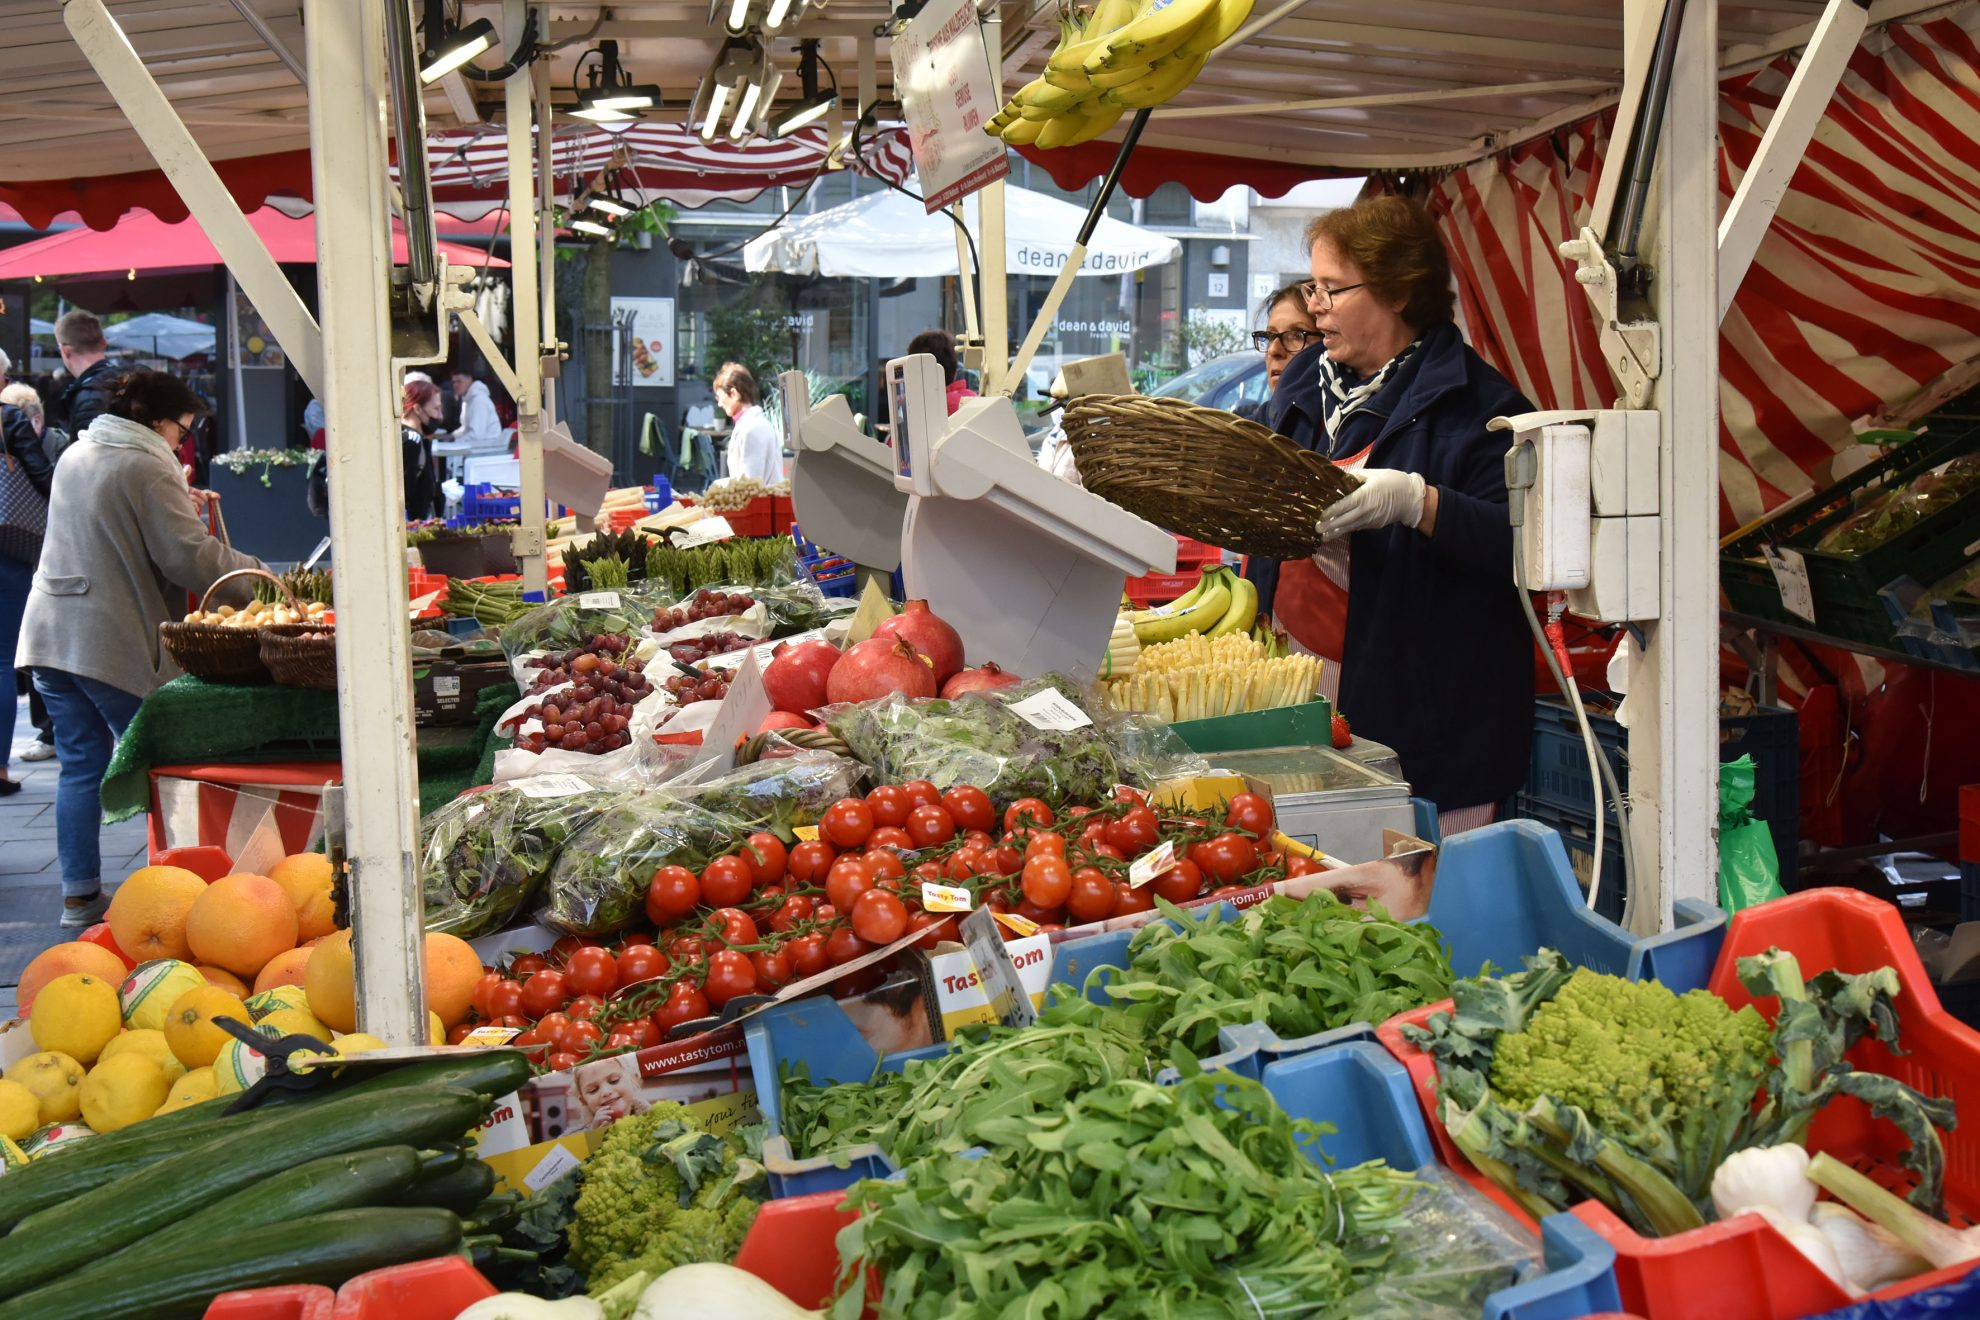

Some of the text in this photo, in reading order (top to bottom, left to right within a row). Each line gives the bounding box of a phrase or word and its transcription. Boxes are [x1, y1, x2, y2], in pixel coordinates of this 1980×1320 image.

[1017, 248, 1068, 268] dean
[1092, 251, 1149, 270] david
[1214, 283, 1224, 293] 12
[1059, 320, 1131, 332] dean & david
[927, 890, 967, 902] Tasty Tom
[1010, 948, 1044, 970] om
[644, 1039, 746, 1071] www.tastytom.n
